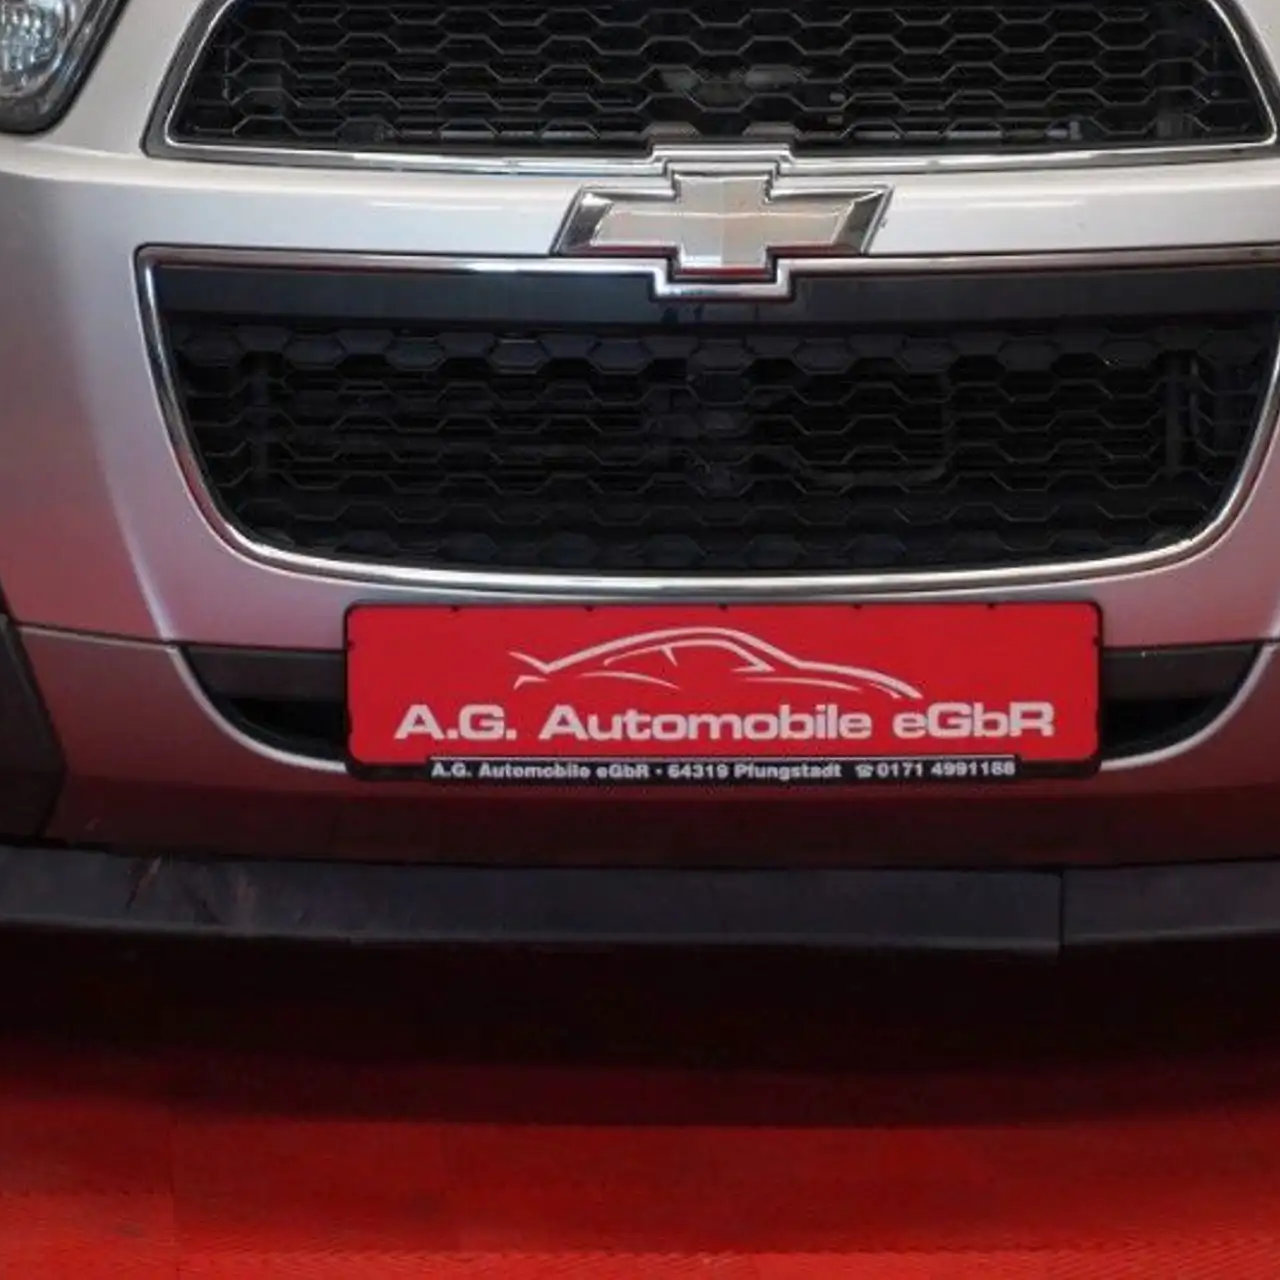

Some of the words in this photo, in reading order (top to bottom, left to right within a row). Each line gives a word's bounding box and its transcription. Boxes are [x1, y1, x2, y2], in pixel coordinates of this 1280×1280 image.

[394, 704, 517, 740] A.G.
[538, 704, 872, 740] Automobile
[893, 701, 1055, 738] eGbR
[431, 762, 472, 778] A.G.
[478, 762, 590, 778] Automobile
[596, 764, 649, 778] eGbR
[733, 762, 842, 781] Pfungstadt
[876, 762, 923, 778] 0171
